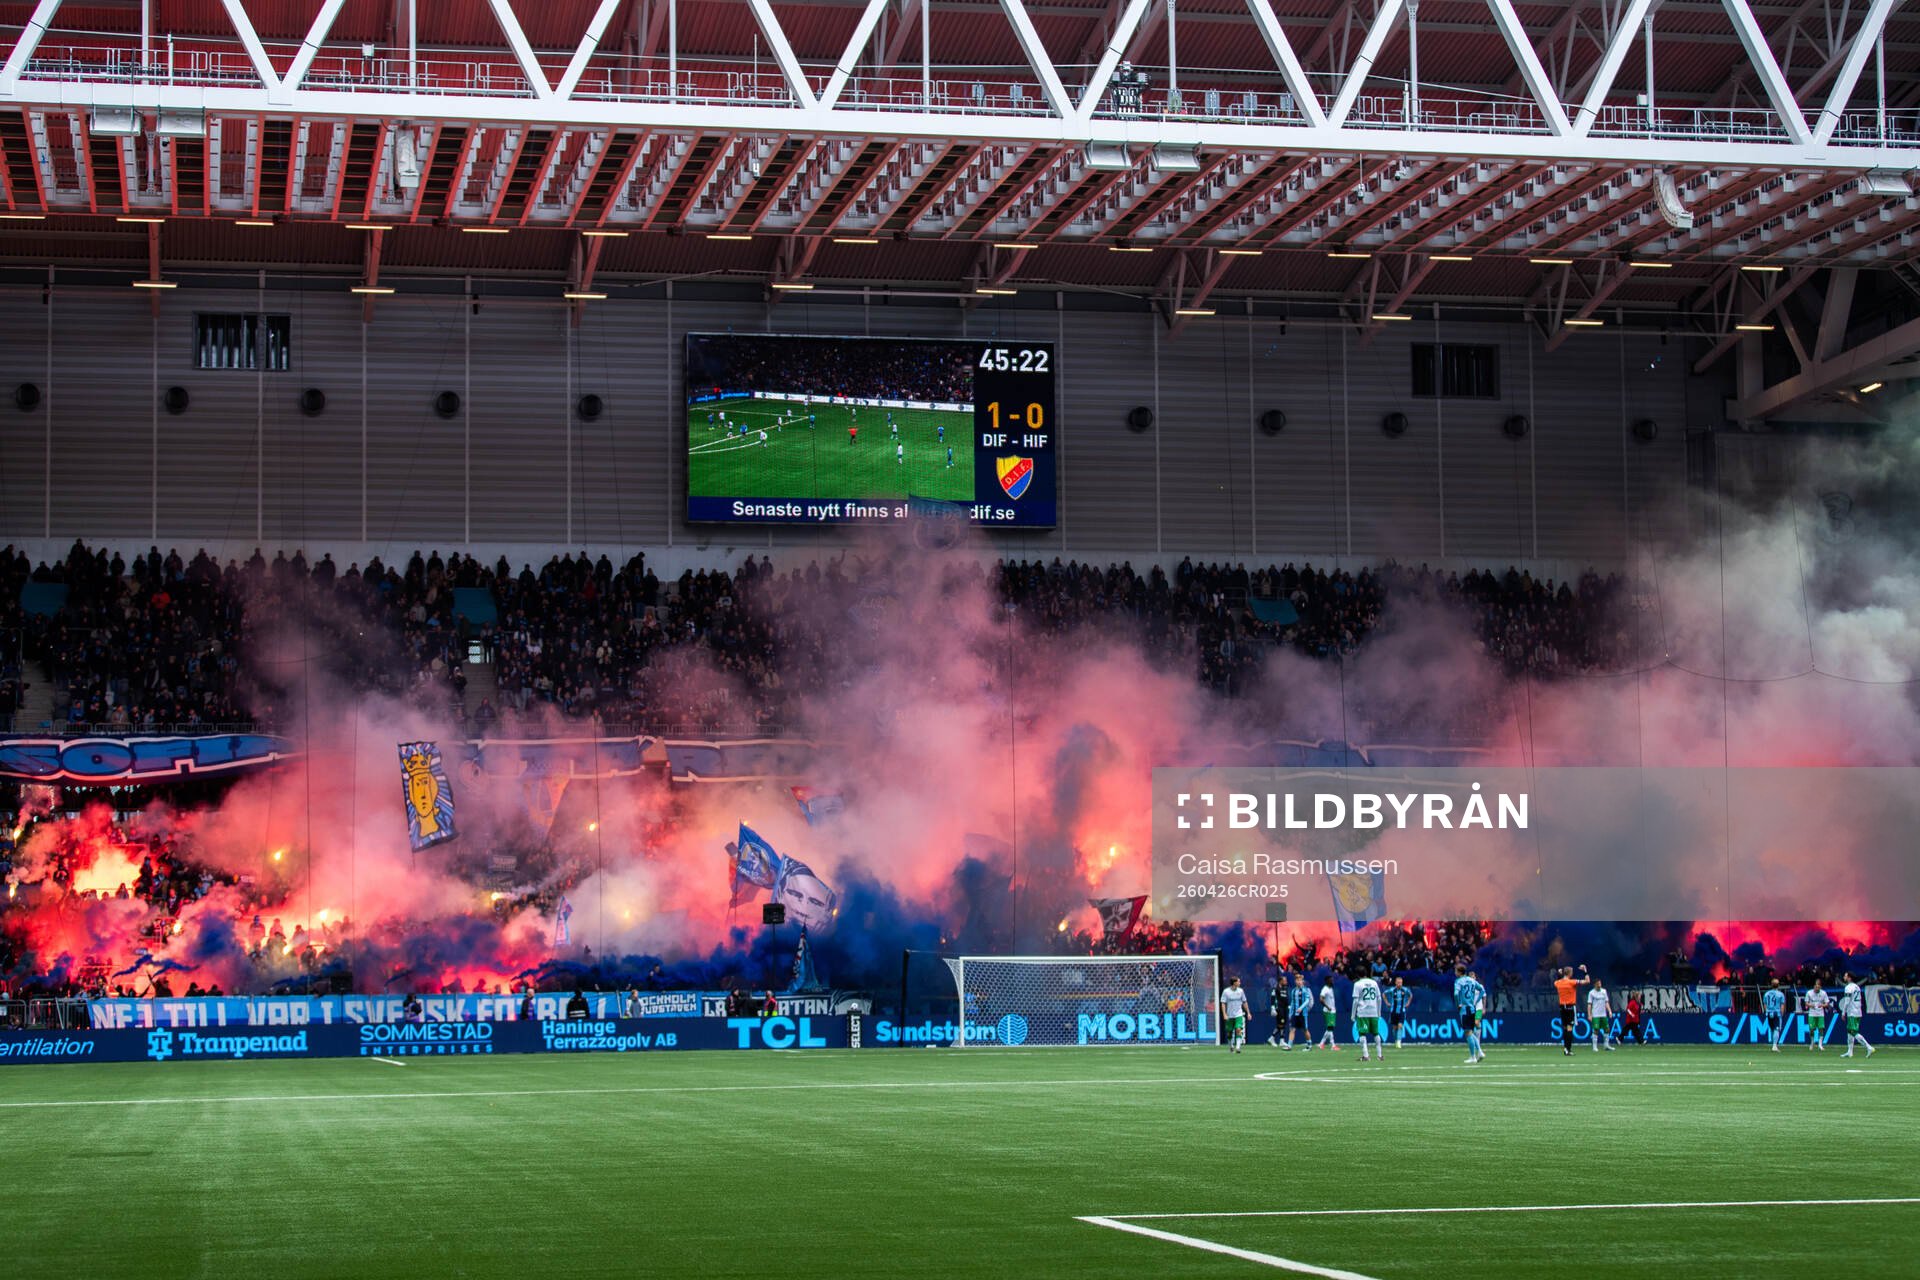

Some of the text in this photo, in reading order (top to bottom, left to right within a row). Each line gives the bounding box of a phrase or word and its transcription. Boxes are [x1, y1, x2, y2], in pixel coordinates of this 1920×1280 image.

[979, 348, 1049, 372] 45:22
[987, 401, 1000, 429] 1
[1026, 402, 1044, 430] 0
[982, 433, 1007, 448] DIF
[1023, 434, 1048, 448] HIF
[732, 501, 802, 516] Senaste
[807, 503, 840, 520] nytt
[845, 503, 889, 518] finns
[1362, 987, 1376, 1001] 26
[360, 1023, 493, 1042] SOMMESTAD
[542, 1019, 616, 1037] Haninge
[727, 1017, 826, 1049] TCL
[850, 1015, 861, 1048] SELECT
[1402, 1019, 1499, 1039] NordVN
[178, 1031, 308, 1058] Tranpenad
[360, 1044, 493, 1055] ENTERPRISES
[543, 1033, 678, 1052] Terrazzogolv AB
